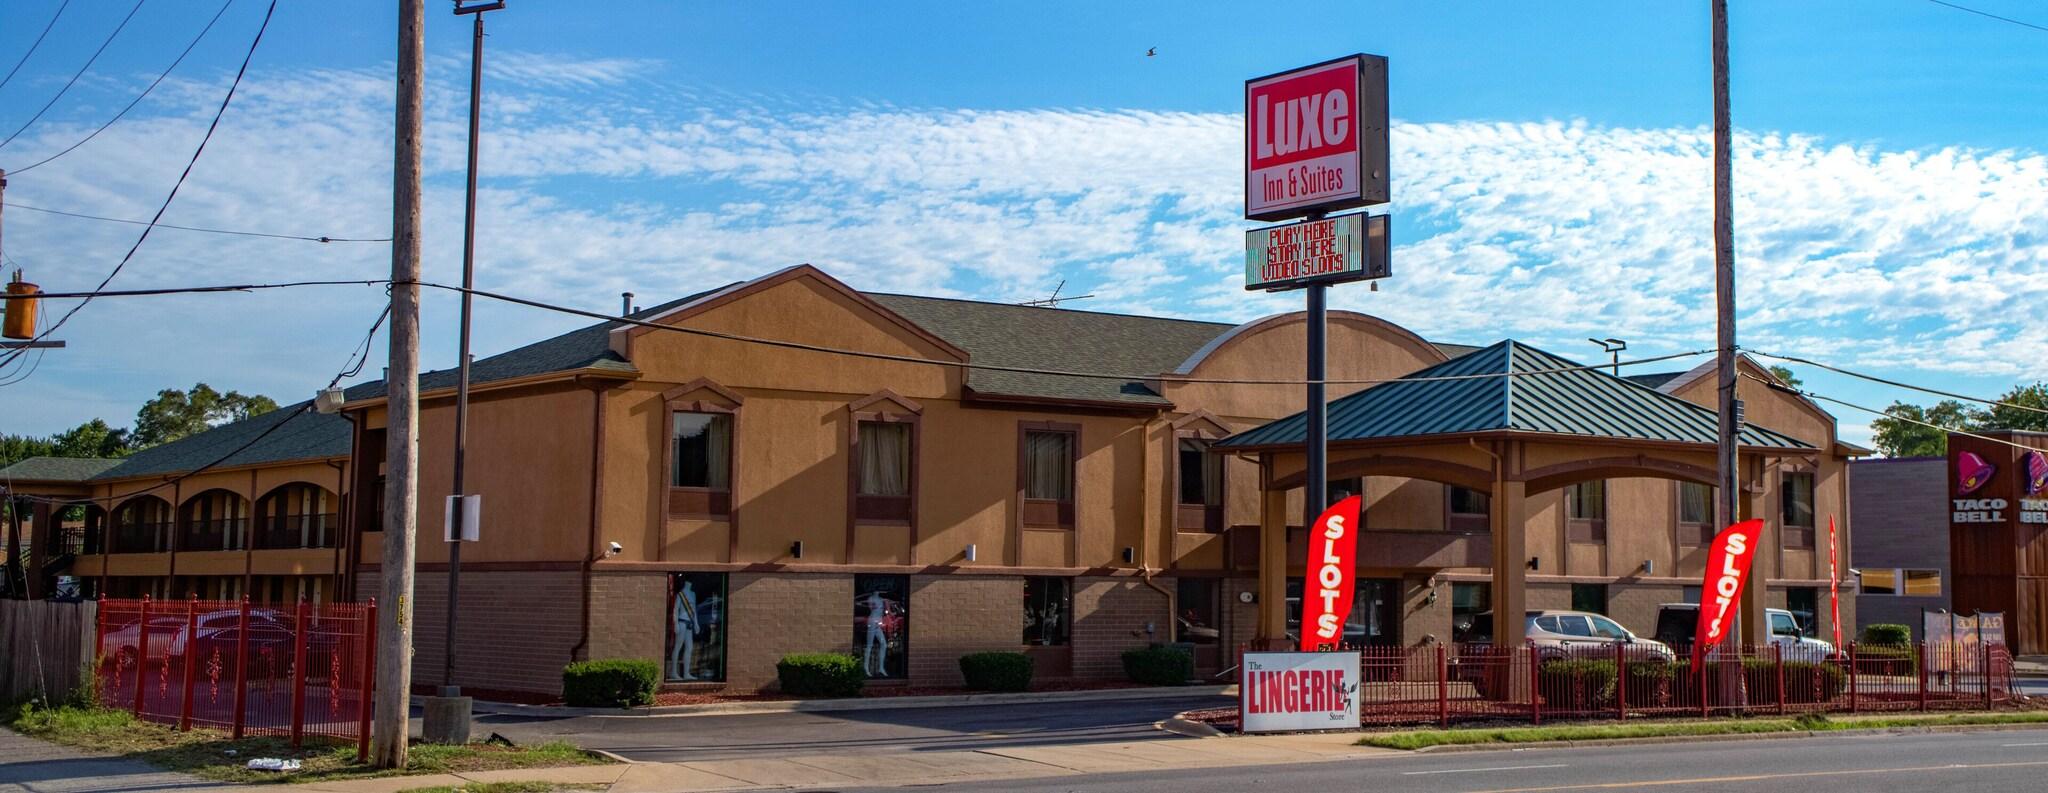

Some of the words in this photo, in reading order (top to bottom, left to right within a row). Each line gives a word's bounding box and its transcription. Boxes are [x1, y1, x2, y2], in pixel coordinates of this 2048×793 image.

[1257, 88, 1349, 160] Luxe
[1264, 173, 1284, 202] Inn
[1288, 168, 1297, 197] &
[1301, 165, 1343, 196] Suites
[1270, 226, 1300, 247] PLAY
[1303, 220, 1336, 242] HERE
[1269, 243, 1300, 264] STAY
[1304, 239, 1335, 259] HERE
[1262, 260, 1299, 281] VIDEO
[1302, 254, 1343, 275] SLOTS
[1953, 498, 2008, 511] TACO
[1953, 511, 2007, 522] BELL
[1316, 514, 1345, 639] SLOTS
[1708, 532, 1747, 638] SLOTS
[1248, 661, 1262, 670] The
[1248, 670, 1344, 714] LINGERIE
[1329, 712, 1345, 721] Store
